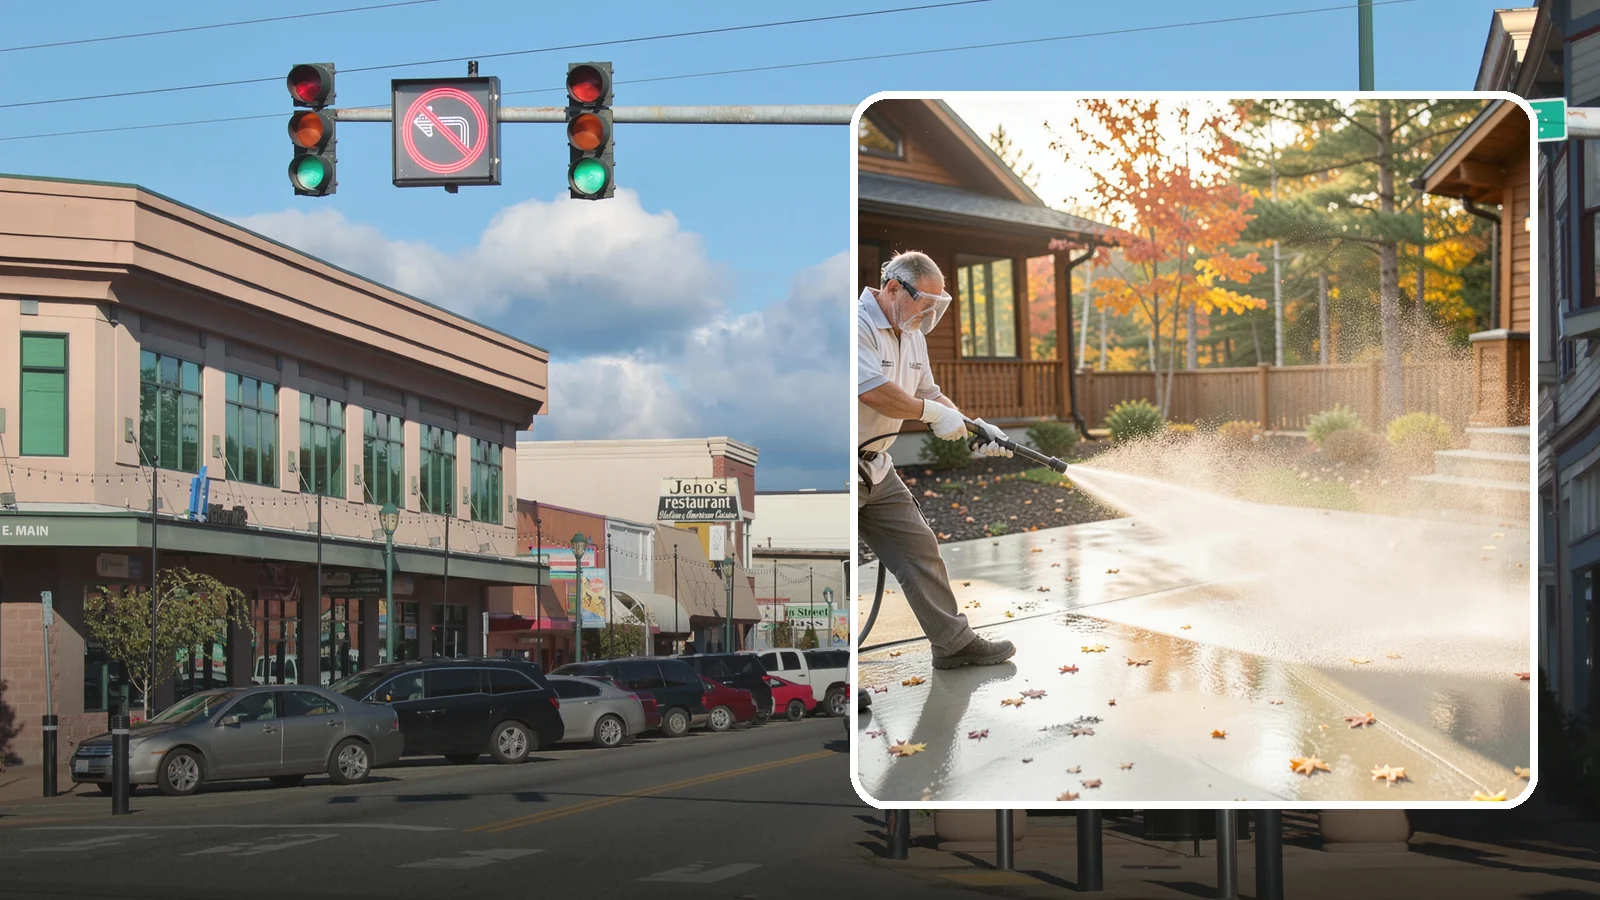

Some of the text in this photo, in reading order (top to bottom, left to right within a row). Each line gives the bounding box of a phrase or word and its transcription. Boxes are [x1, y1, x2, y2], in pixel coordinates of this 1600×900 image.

[670, 480, 727, 494] Jeno's
[665, 496, 730, 508] restaurant
[658, 510, 680, 519] Italian
[686, 510, 714, 519] American
[715, 510, 737, 519] Cuisine
[2, 525, 49, 536] E. MAIN
[798, 608, 828, 616] Street
